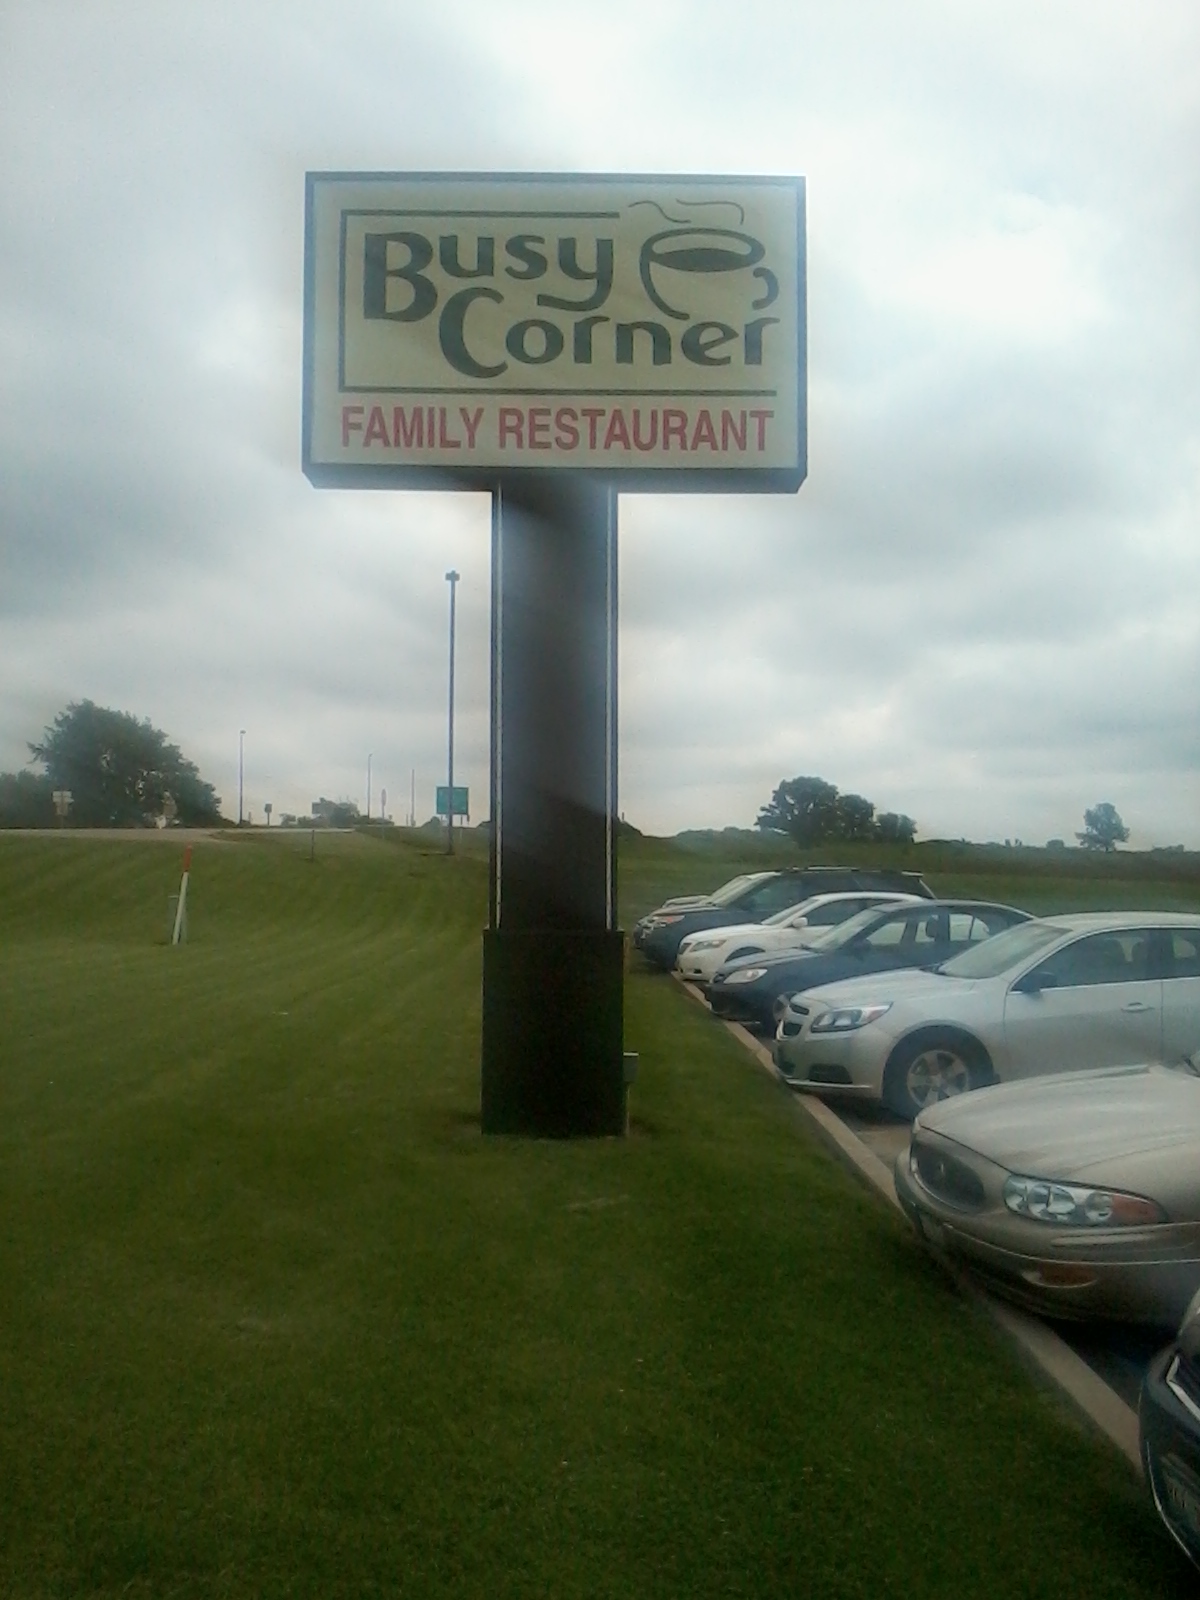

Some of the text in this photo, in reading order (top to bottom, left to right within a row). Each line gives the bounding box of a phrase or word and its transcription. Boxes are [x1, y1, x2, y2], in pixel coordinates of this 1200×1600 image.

[363, 232, 614, 322] Busy
[438, 286, 780, 378] Corner
[341, 406, 774, 452] FAMILY RESTAURANT
